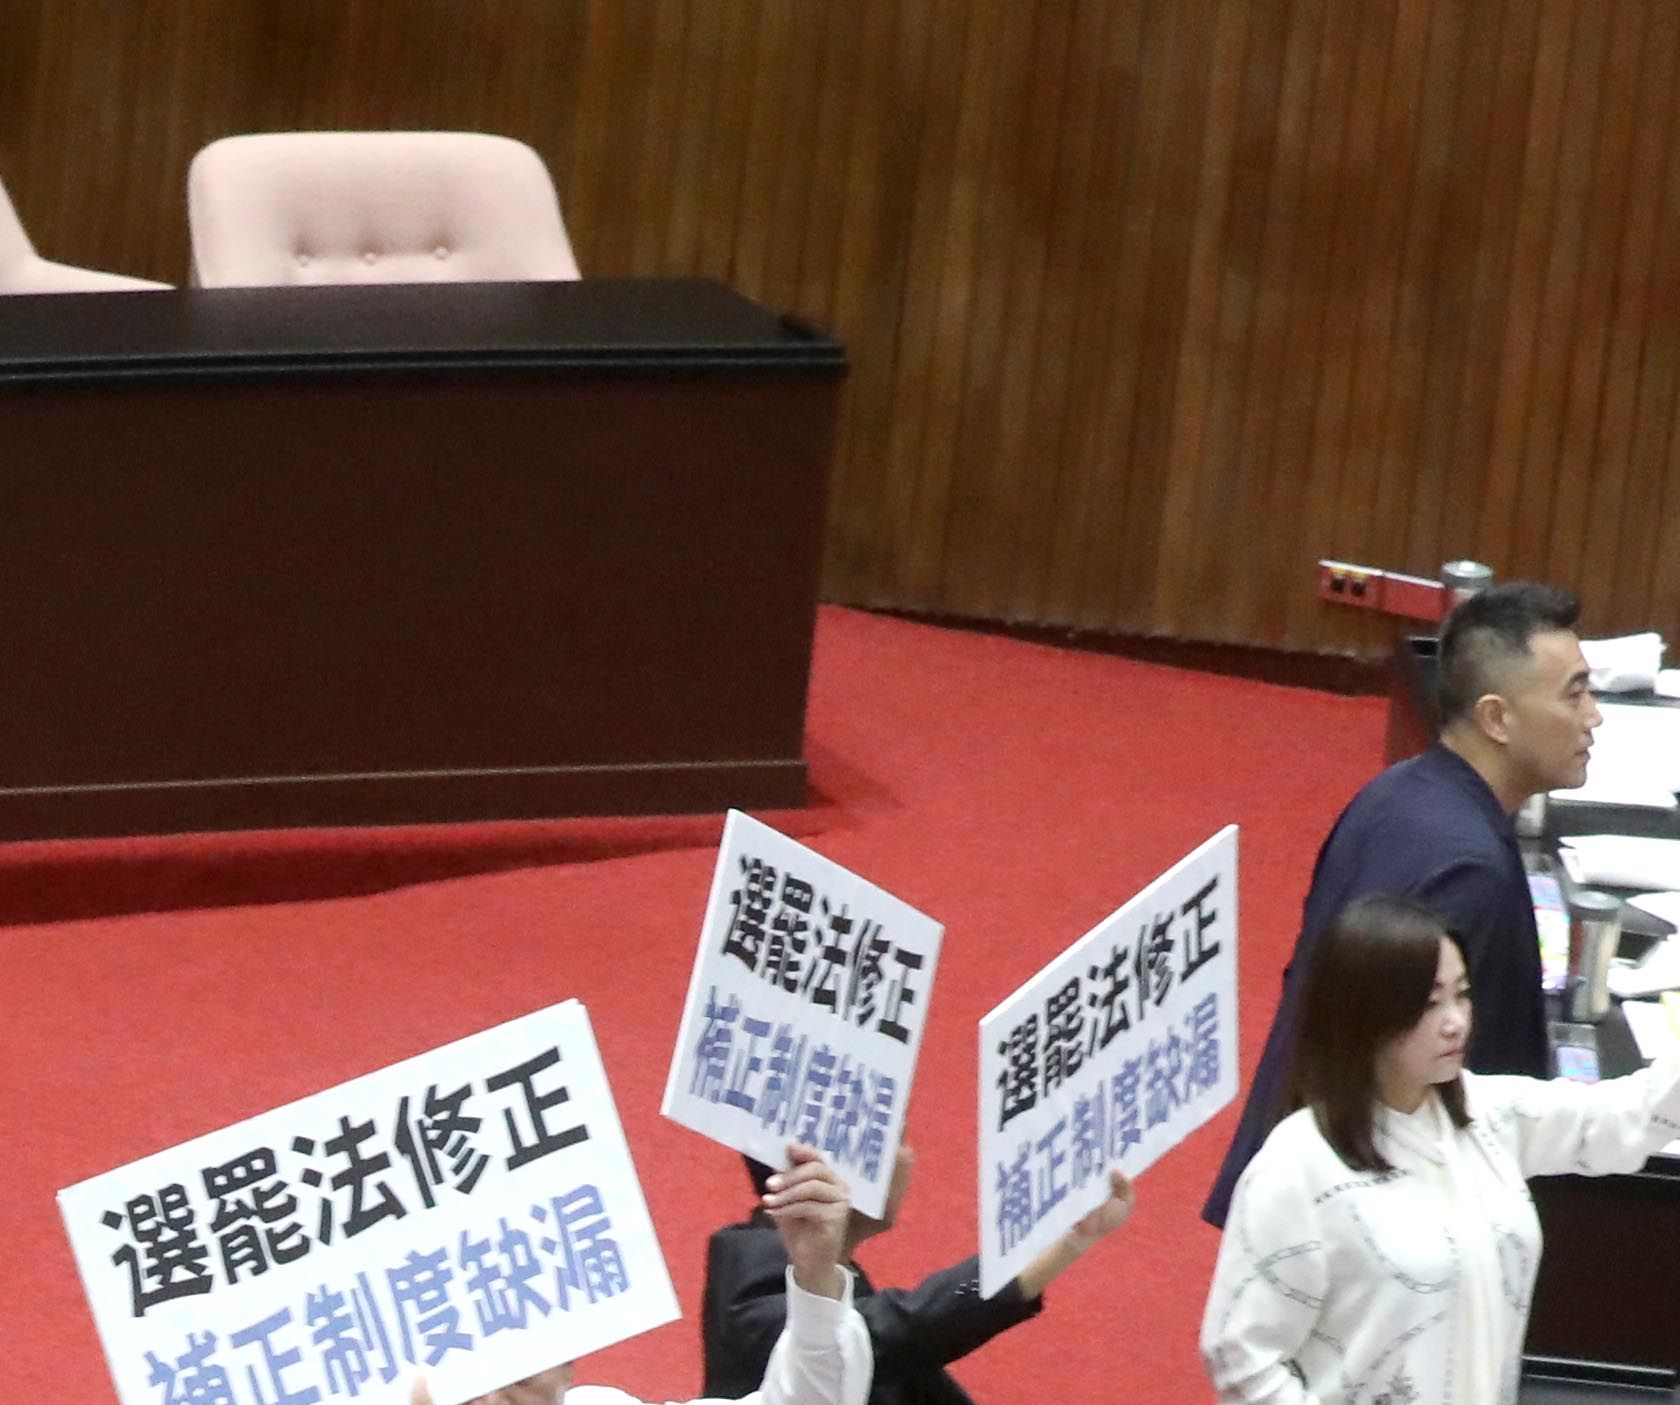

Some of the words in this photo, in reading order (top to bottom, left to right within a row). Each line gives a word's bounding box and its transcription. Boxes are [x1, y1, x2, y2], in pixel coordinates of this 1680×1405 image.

[721, 854, 925, 1048] 選罷法修正
[995, 874, 1223, 1128] 選罷法修正
[100, 1044, 590, 1317] 選罷法修正
[691, 985, 898, 1186] 補正制度缺漏
[993, 990, 1223, 1257] 補正制度缺漏
